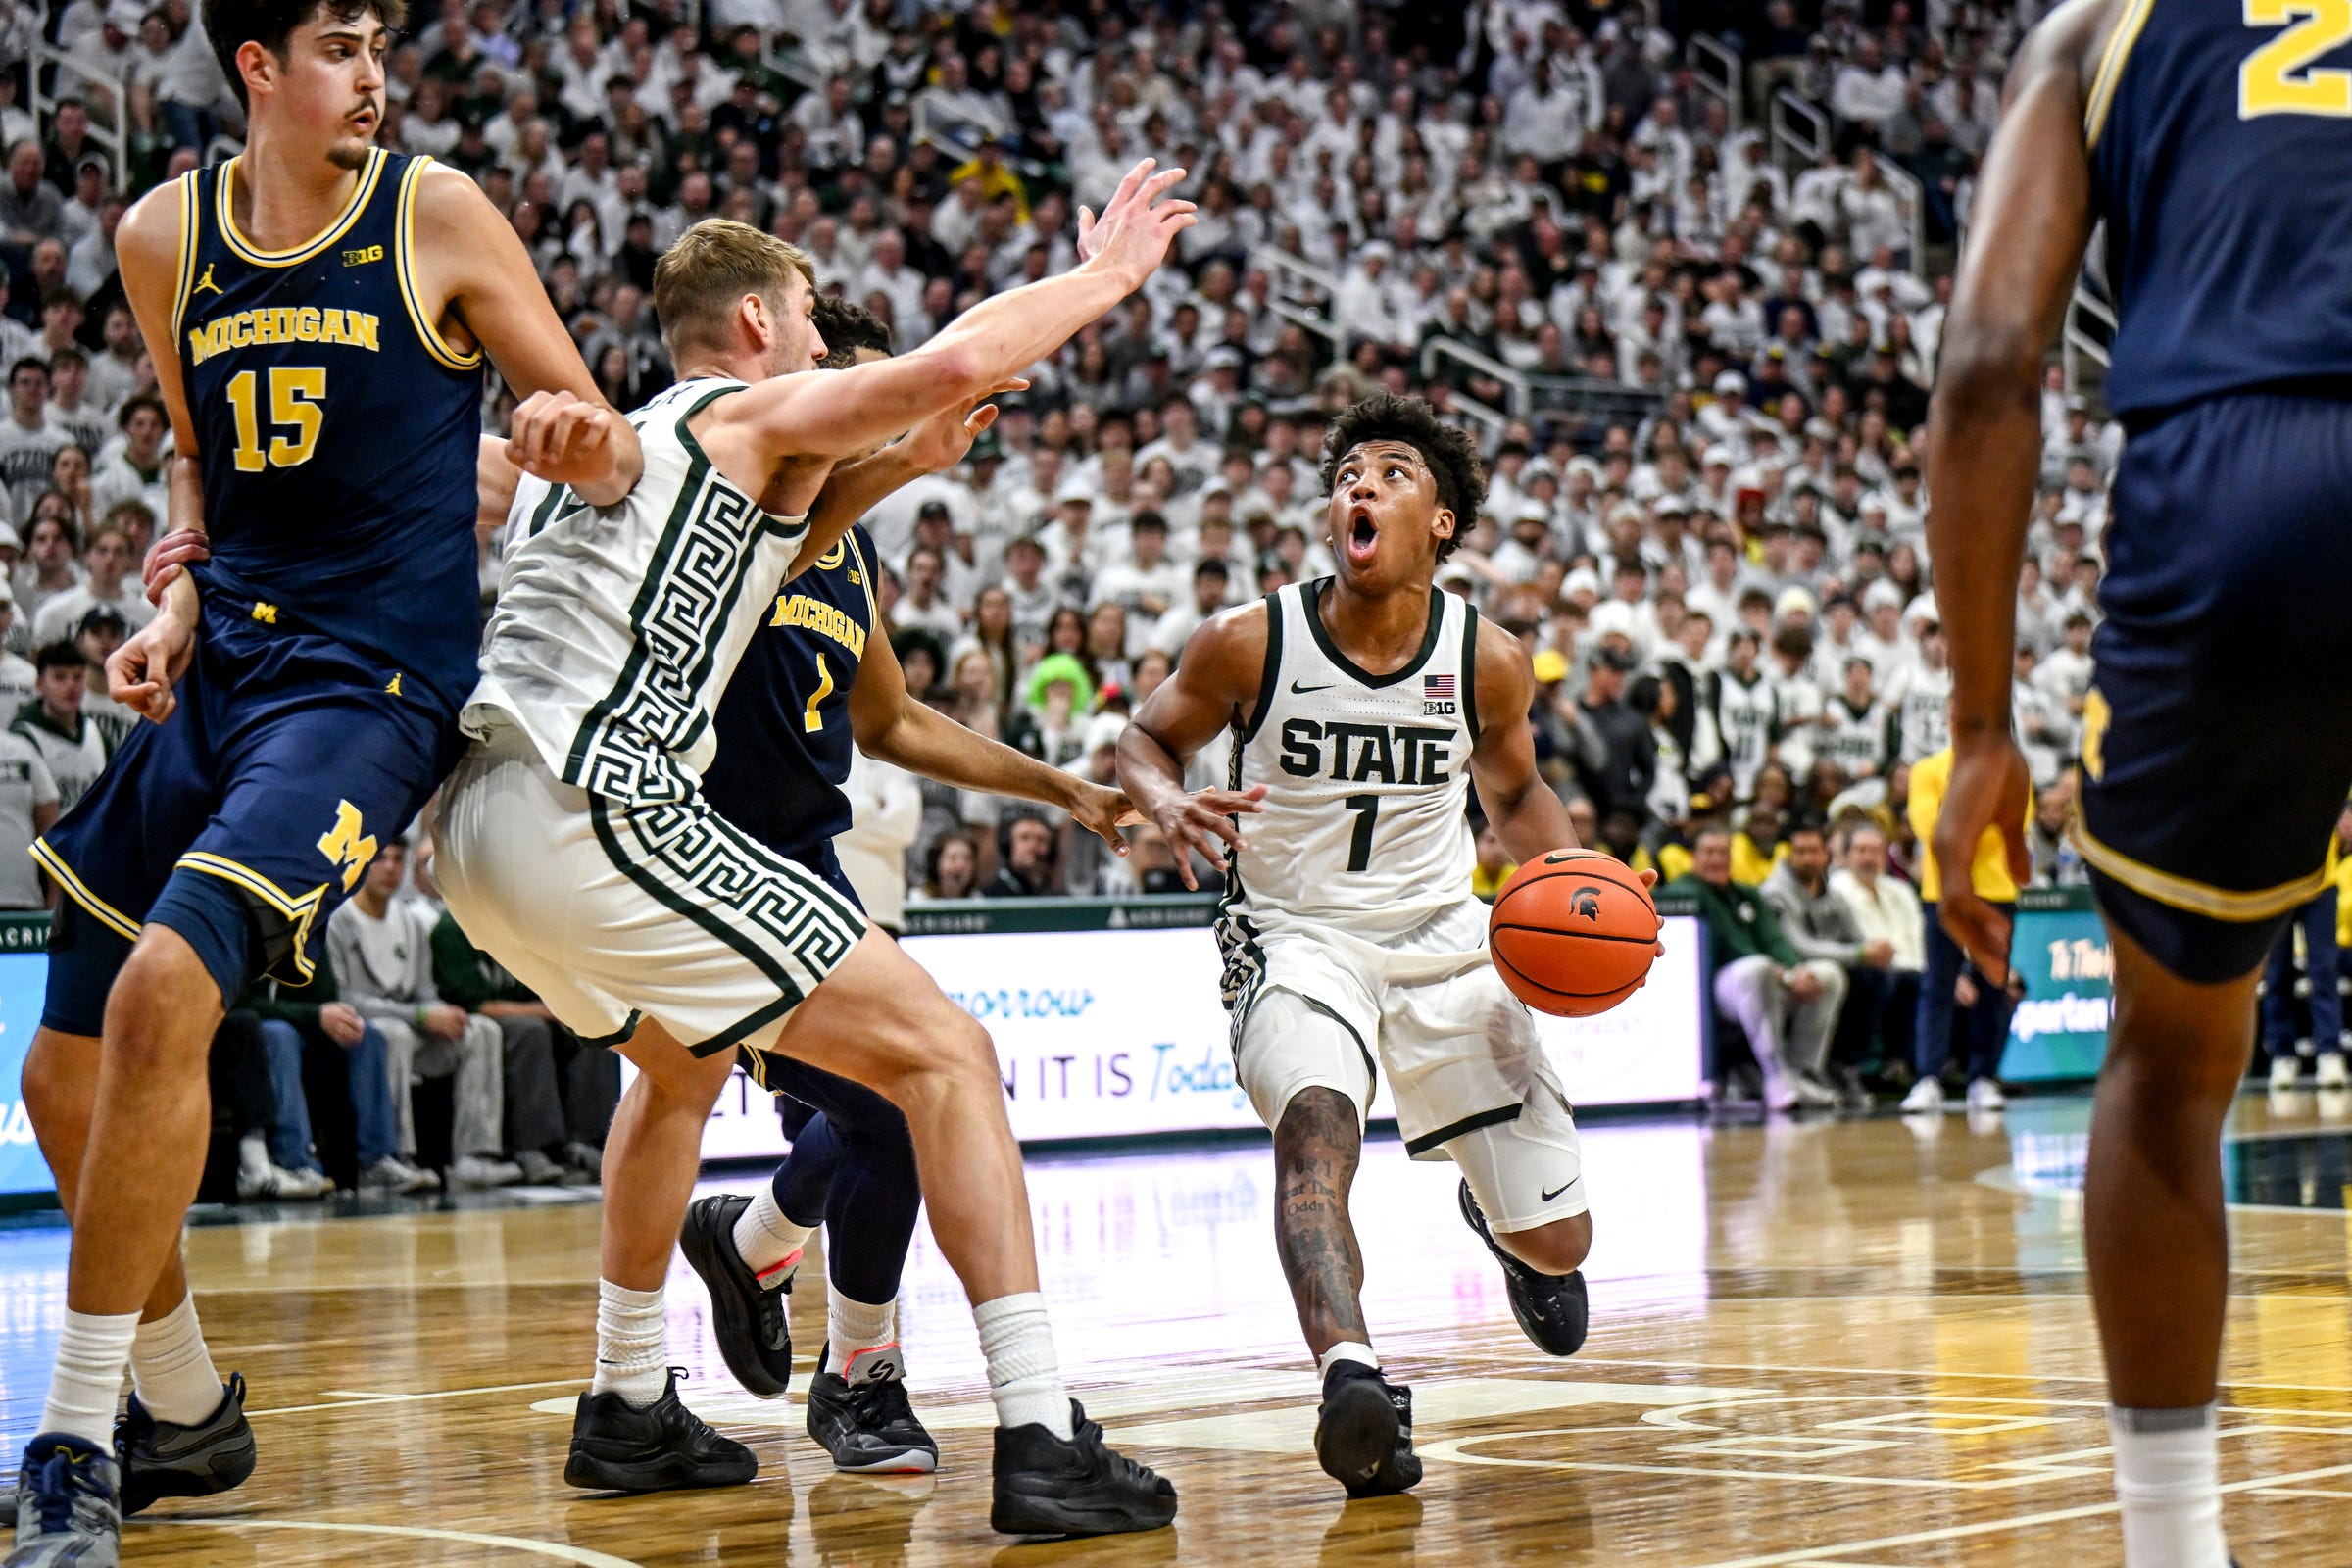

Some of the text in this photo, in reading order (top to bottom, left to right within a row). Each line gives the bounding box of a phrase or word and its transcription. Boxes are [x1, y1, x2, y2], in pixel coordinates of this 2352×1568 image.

[2237, 0, 2352, 121] 2
[342, 244, 384, 268] B1G
[188, 306, 380, 367] MICHIGAN
[225, 366, 327, 472] 15
[251, 601, 278, 624] M
[768, 594, 866, 664] MICHIGAN
[804, 652, 834, 733] 1
[1423, 700, 1456, 715] B1G
[1279, 717, 1458, 785] STATE
[316, 798, 378, 894] M
[1345, 793, 1379, 872] 1
[1038, 1055, 1076, 1101] IT
[1095, 1053, 1132, 1098] IS
[1287, 1200, 1325, 1216] Odds
